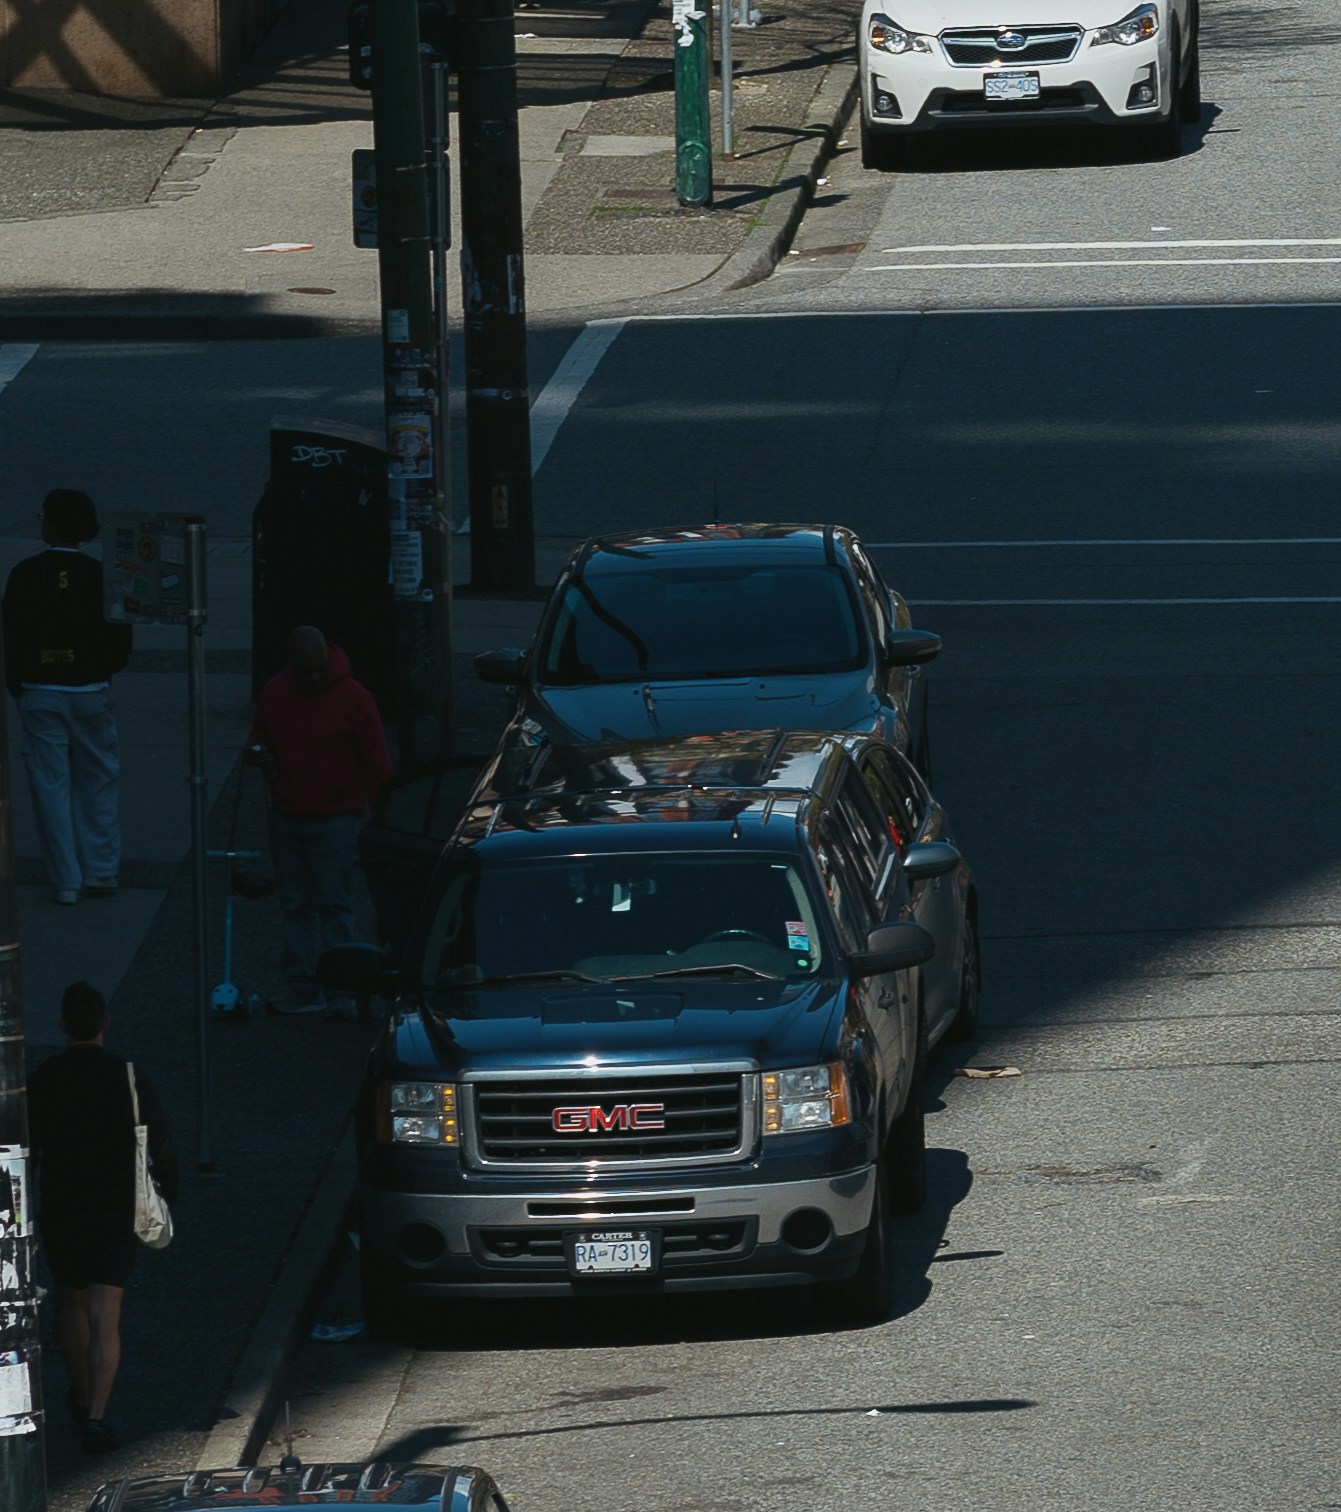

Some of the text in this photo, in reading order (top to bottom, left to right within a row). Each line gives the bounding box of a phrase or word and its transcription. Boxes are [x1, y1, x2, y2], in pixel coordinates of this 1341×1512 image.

[58, 570, 69, 589] 5
[552, 1103, 665, 1133] GMC
[591, 1232, 633, 1240] CARTER
